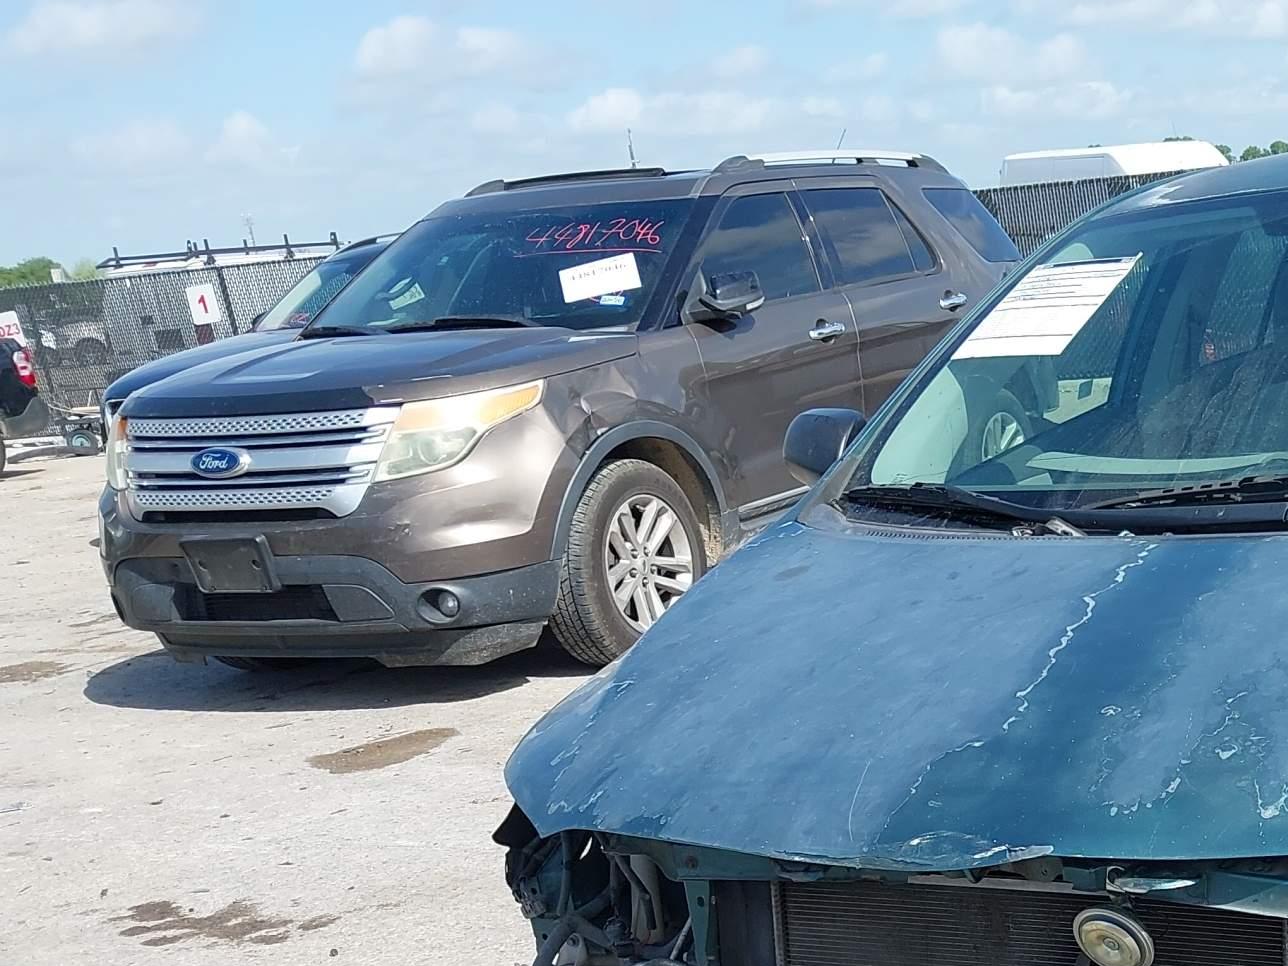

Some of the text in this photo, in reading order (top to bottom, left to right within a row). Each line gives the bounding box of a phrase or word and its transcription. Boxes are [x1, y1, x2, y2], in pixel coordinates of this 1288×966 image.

[525, 218, 664, 249] 44817046
[198, 294, 208, 314] 1
[199, 453, 229, 469] Ford
